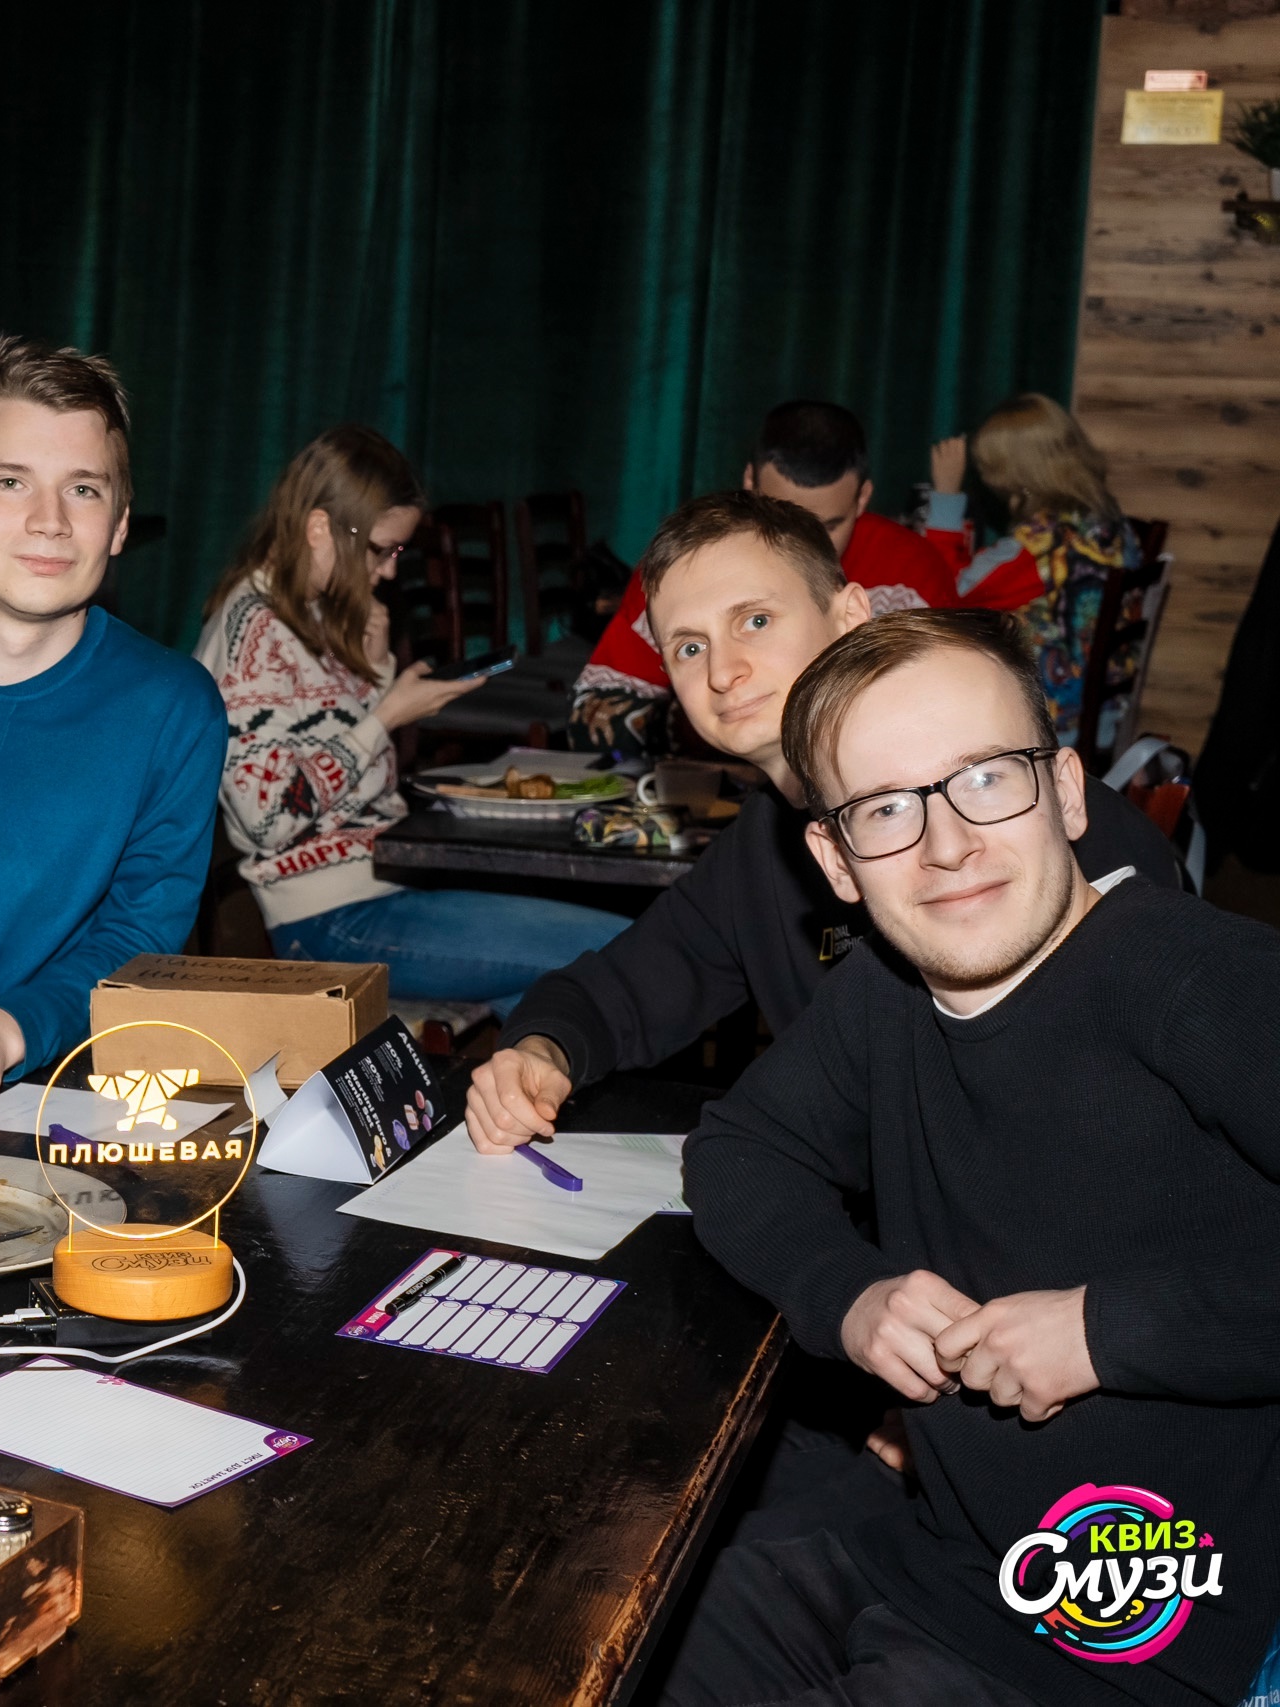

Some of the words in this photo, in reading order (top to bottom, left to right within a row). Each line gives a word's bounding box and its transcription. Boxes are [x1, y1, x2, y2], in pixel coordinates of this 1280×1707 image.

[344, 1072, 363, 1105] Tonic
[362, 1106, 374, 1128] Set
[348, 1068, 375, 1112] Martini
[49, 1140, 242, 1164] ПЛЮШЕВАЯ
